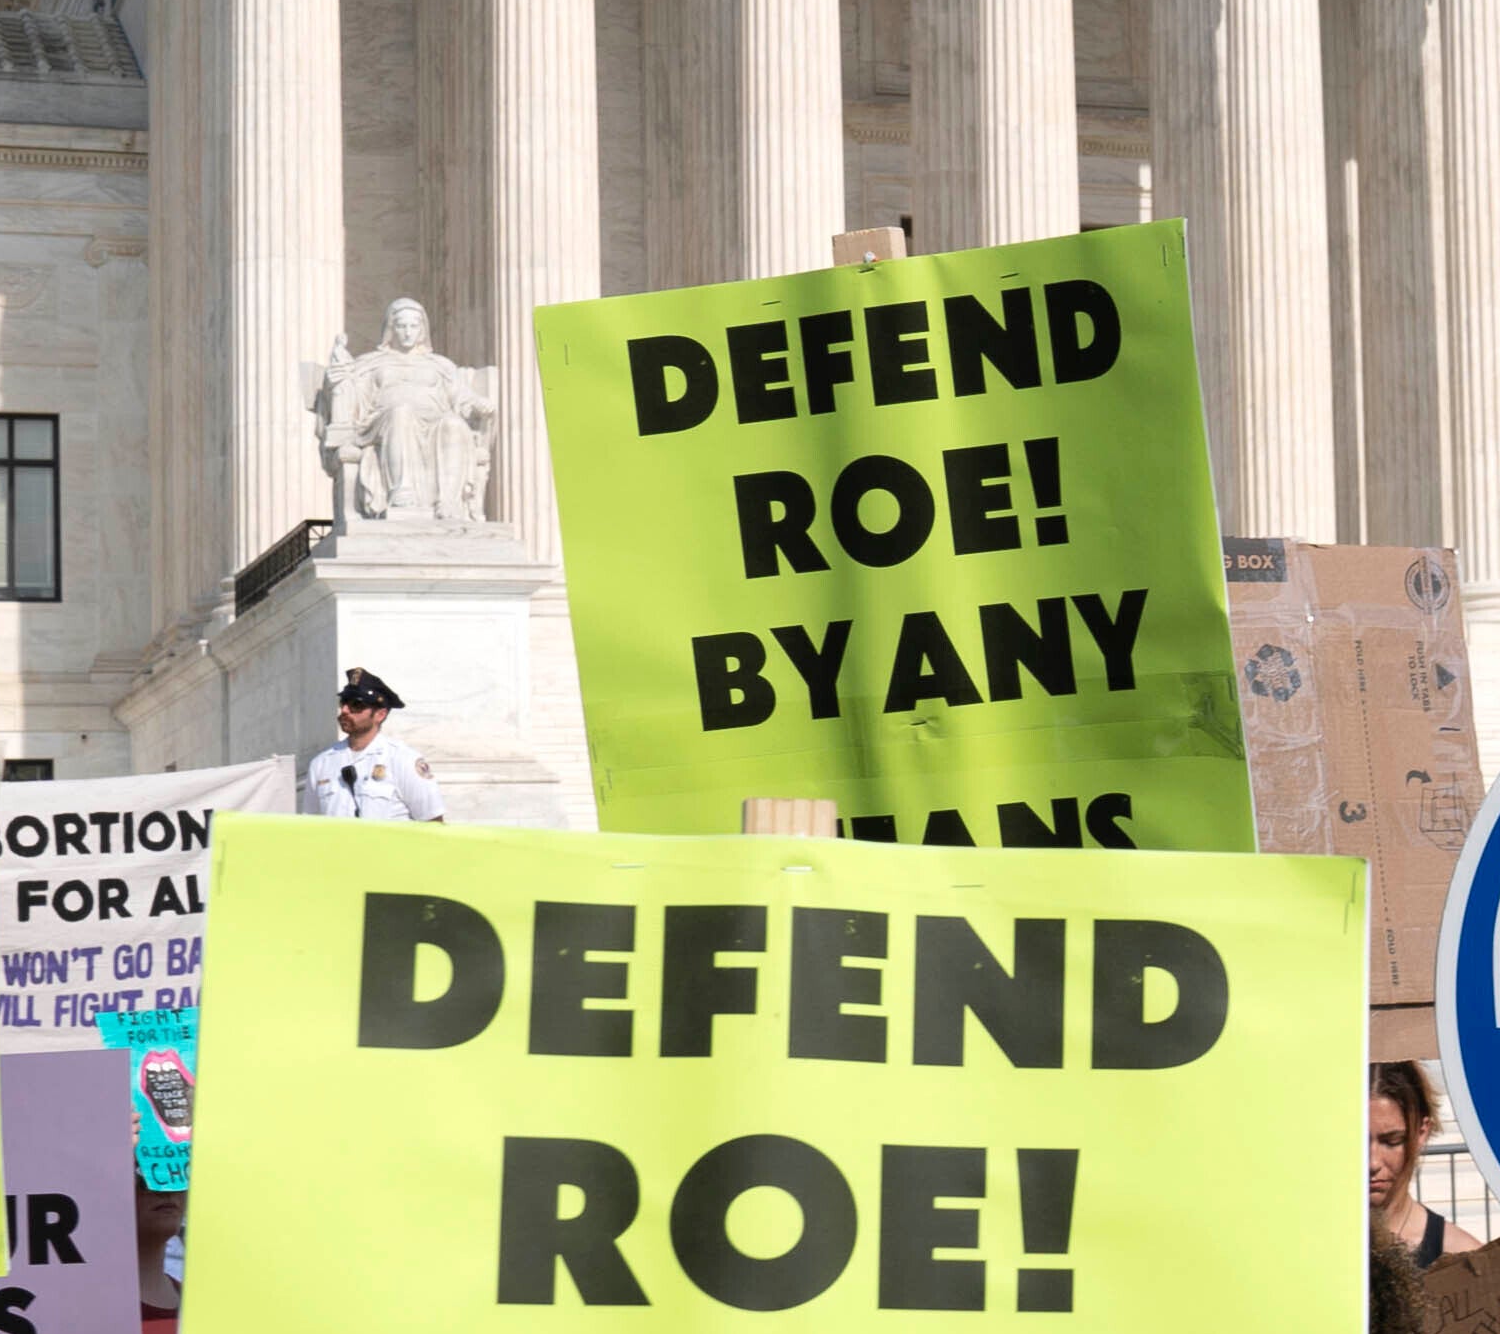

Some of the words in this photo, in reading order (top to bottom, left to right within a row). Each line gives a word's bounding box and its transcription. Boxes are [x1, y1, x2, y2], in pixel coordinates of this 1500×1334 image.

[627, 279, 1122, 437] DEFEND
[733, 437, 1070, 579] ROE!
[1237, 555, 1275, 569] BOX
[692, 619, 853, 731] BY
[882, 588, 1148, 714] ANY
[1338, 800, 1367, 823] 3
[17, 878, 132, 922] FOR
[2, 947, 103, 987] WON'T
[113, 942, 153, 980] GO
[357, 891, 1229, 1070] DEFEND
[117, 1009, 184, 1026] FIGHT
[127, 1030, 158, 1045] FOR
[161, 1026, 192, 1043] THE
[0, 1193, 86, 1267] R
[496, 1133, 1079, 1312] ROE!
